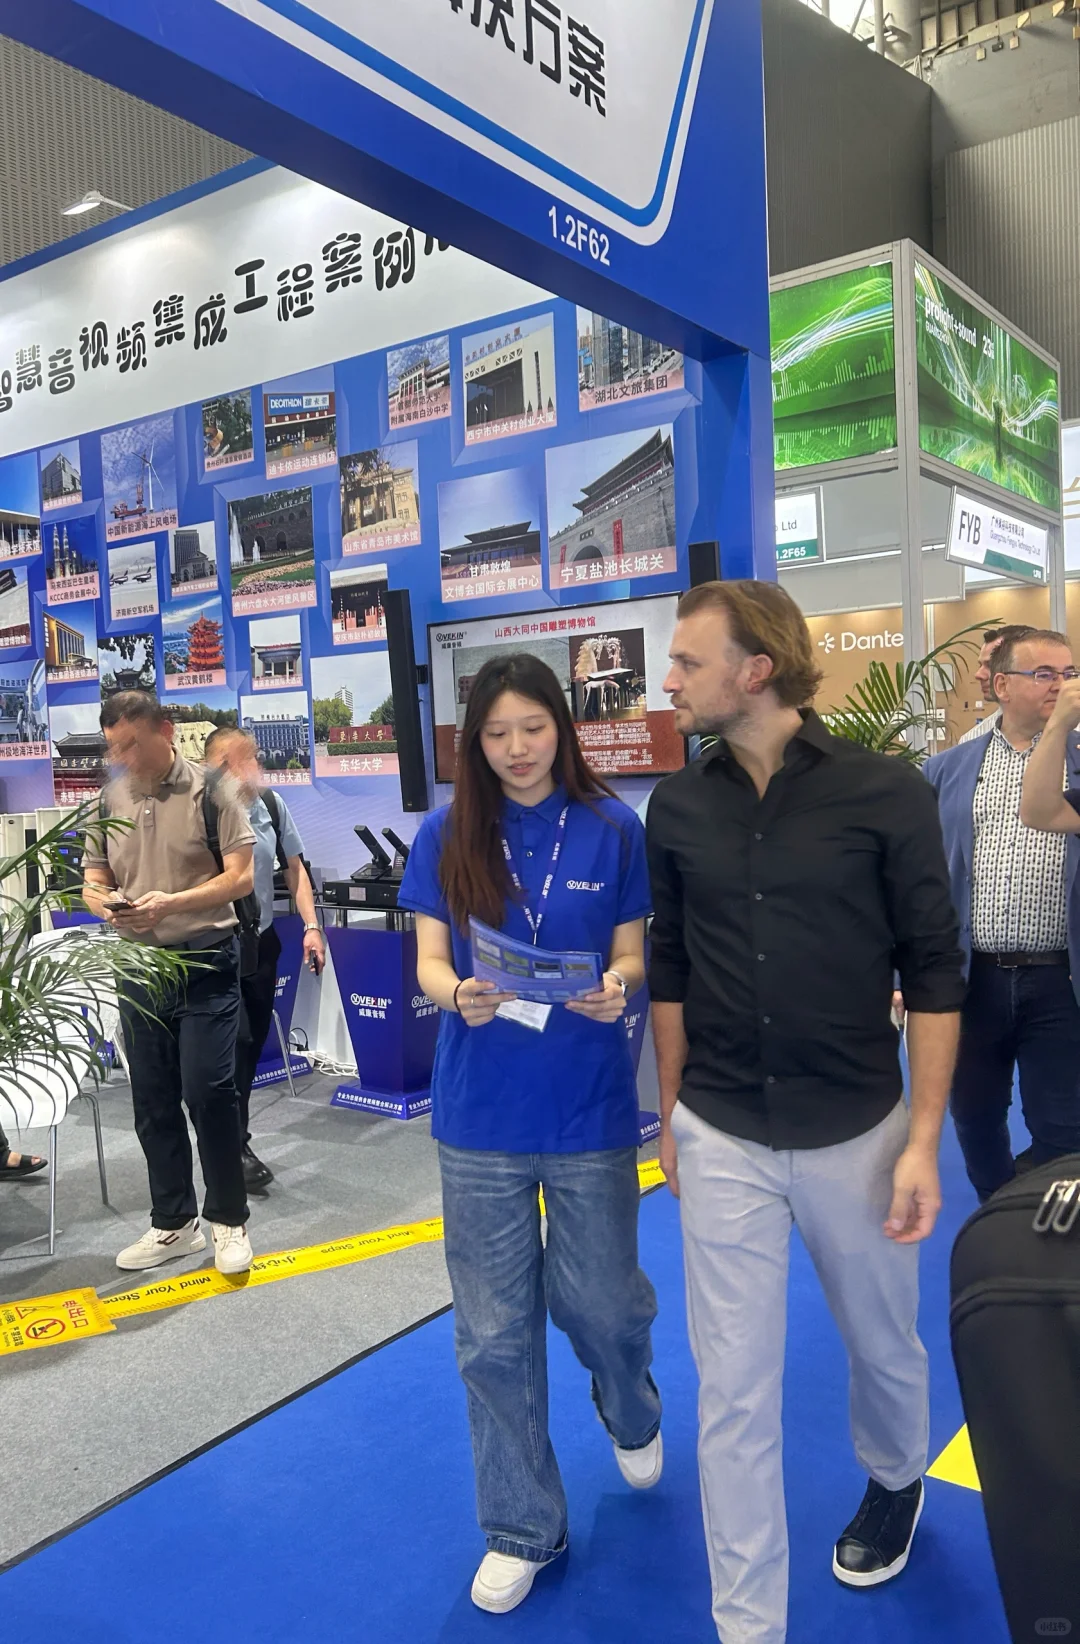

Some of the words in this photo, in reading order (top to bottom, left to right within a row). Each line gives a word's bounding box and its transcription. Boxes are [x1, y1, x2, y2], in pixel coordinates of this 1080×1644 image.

[451, 0, 606, 117] 决方案
[548, 205, 610, 266] 1.2F62
[0, 226, 450, 413] 慧音视频集成工程案例
[595, 375, 668, 404] 湖北文旅集团
[466, 412, 556, 440] 西宁市中关村创业大厦
[107, 514, 177, 537] 中国新能源海上风电场
[781, 519, 797, 531] Ltd
[958, 510, 981, 545] FYB
[344, 530, 419, 552] 山东省青岛市美术馆
[776, 547, 807, 560] 1.2F65
[469, 560, 511, 578] 甘肃敦煌
[561, 553, 664, 583] 宁夏盐池长城关
[444, 574, 540, 599] 文博会国际会展中心
[494, 616, 596, 639] 山西大同中国雕塑博物馆
[841, 630, 904, 651] Dante
[177, 674, 213, 686] 武汉黄鹤楼
[339, 757, 383, 772] 东华大学
[260, 773, 310, 784] 邢侯台大酒店
[320, 1242, 355, 1256] Steps
[358, 1236, 384, 1247] Your
[145, 1285, 176, 1301] Your
[178, 1276, 211, 1291] Mind
